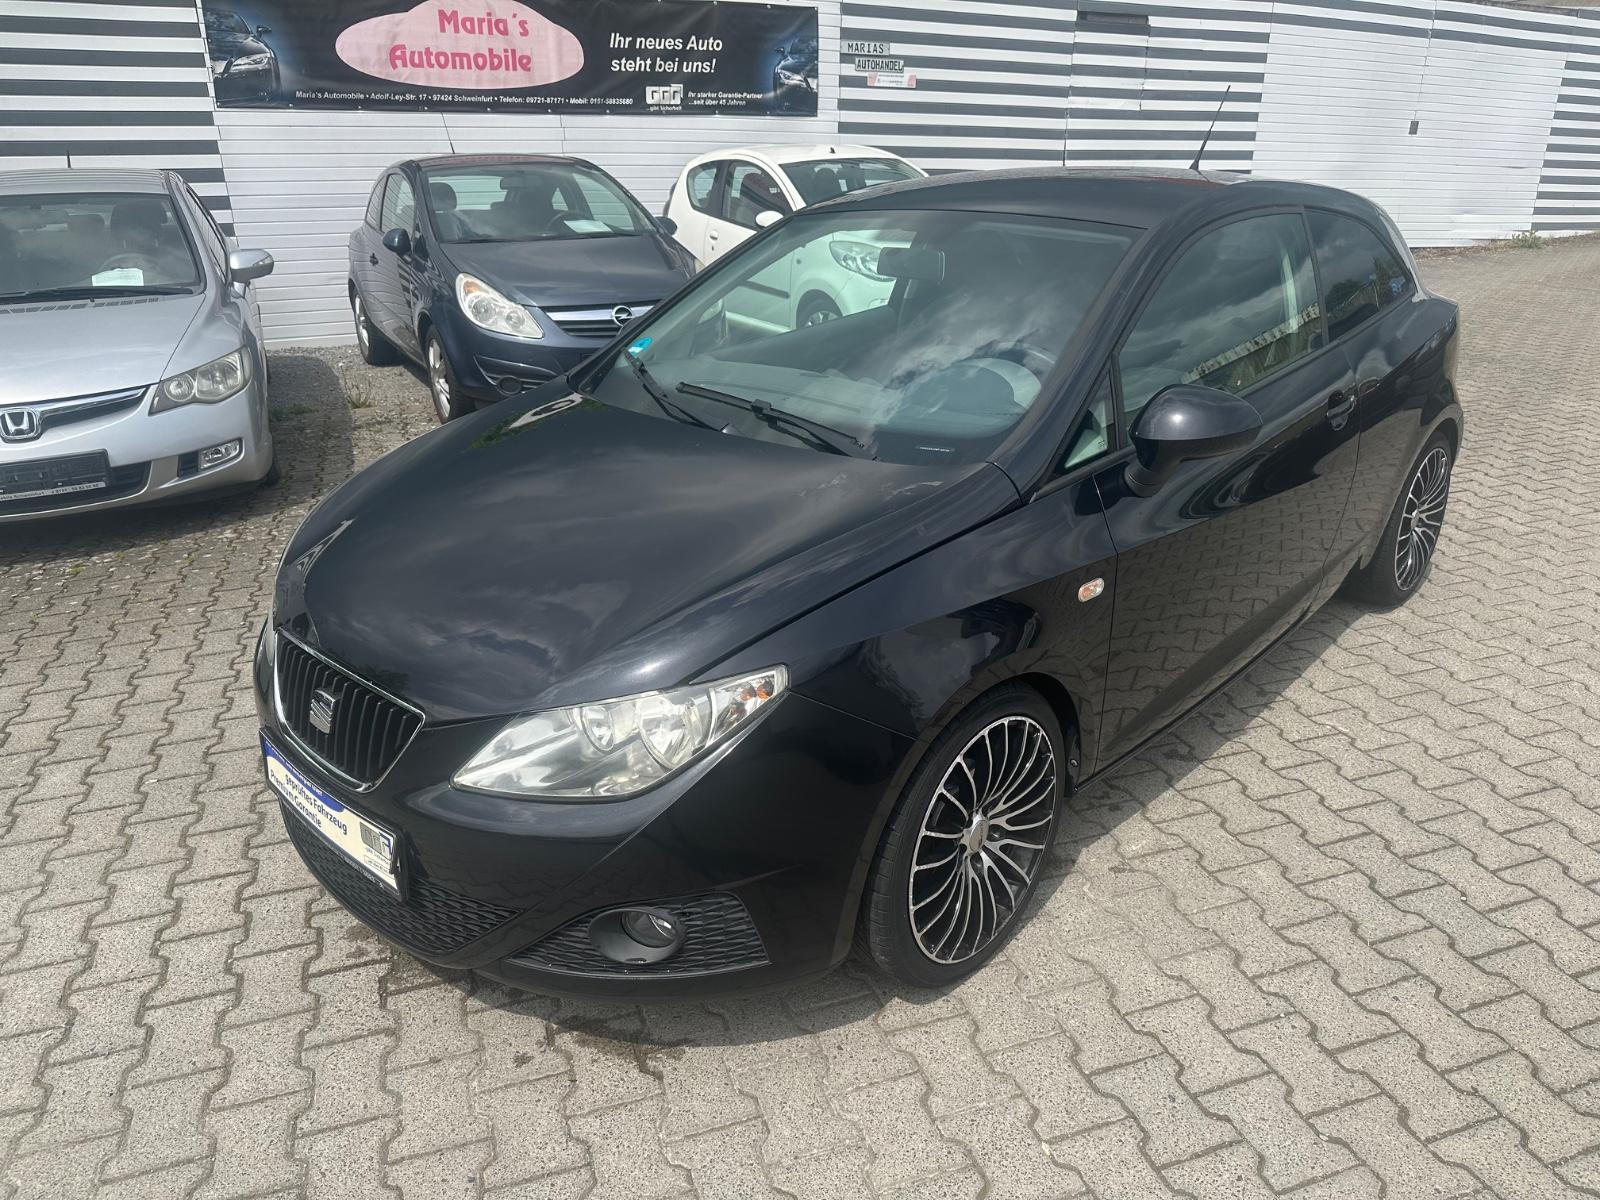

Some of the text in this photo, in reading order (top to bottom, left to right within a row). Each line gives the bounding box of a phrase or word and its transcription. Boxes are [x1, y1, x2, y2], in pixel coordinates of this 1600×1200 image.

[609, 33, 723, 51] Ihr neues Auto
[847, 42, 884, 54] MARIAS
[389, 44, 532, 72] Automobile
[610, 57, 717, 73] steht bei uns!
[856, 59, 903, 71] AUTOHANDEL
[323, 91, 365, 100] Automobile
[453, 95, 493, 103] Schweinfurt
[294, 795, 322, 828] Garantie
[313, 798, 348, 836] Fahrzeug
